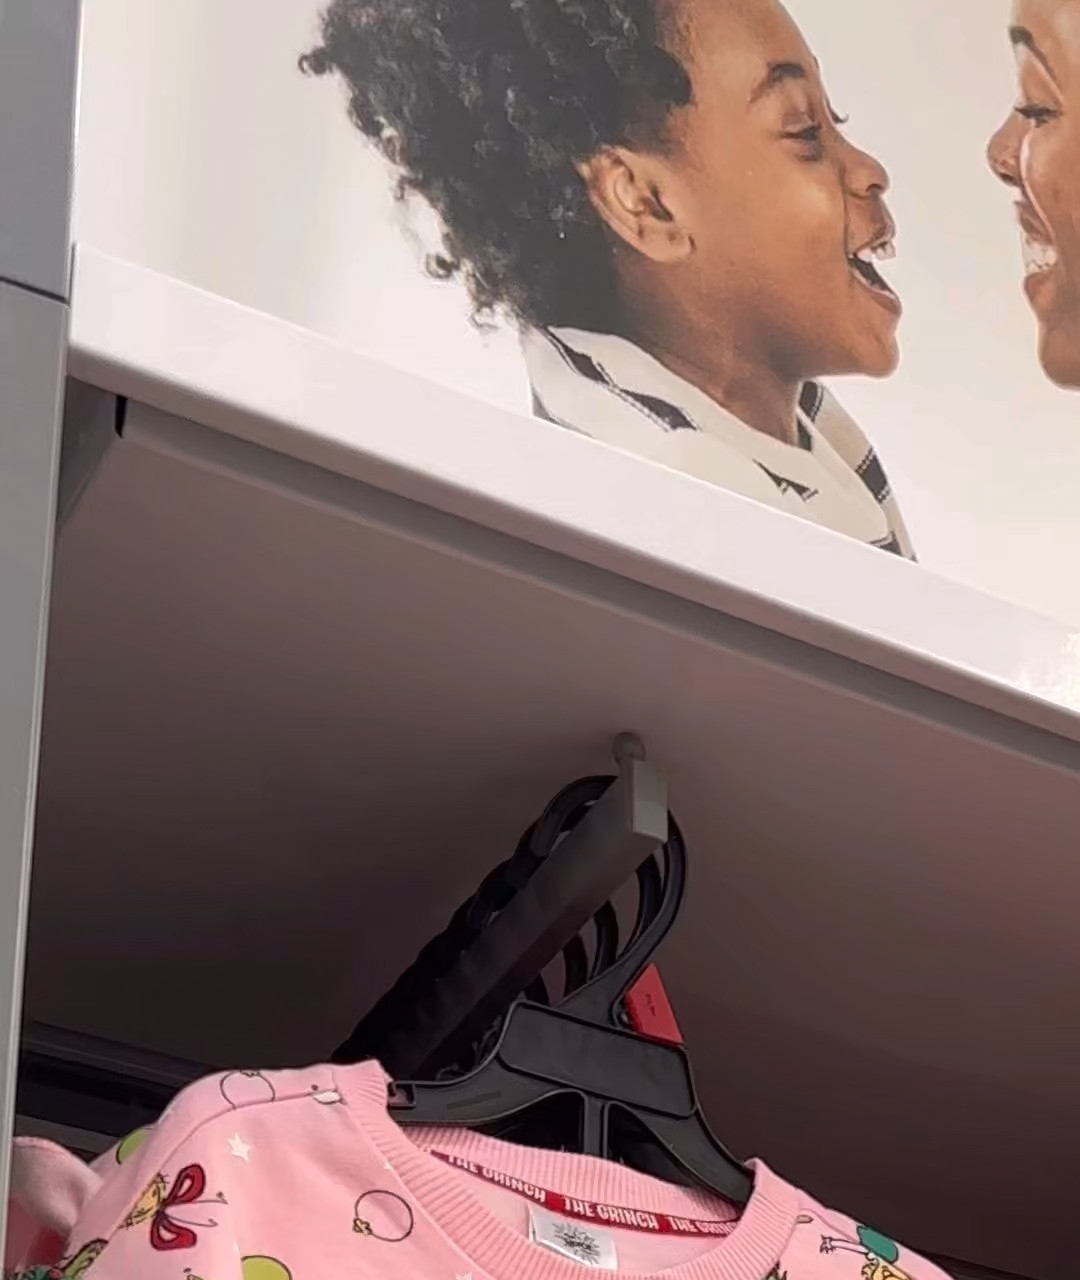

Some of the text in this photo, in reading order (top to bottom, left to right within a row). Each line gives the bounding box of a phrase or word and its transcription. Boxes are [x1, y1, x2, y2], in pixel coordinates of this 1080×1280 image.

[447, 1155, 479, 1174] THE
[563, 1197, 595, 1218] THE
[596, 1204, 660, 1230] GRINCH
[667, 1216, 698, 1233] THE
